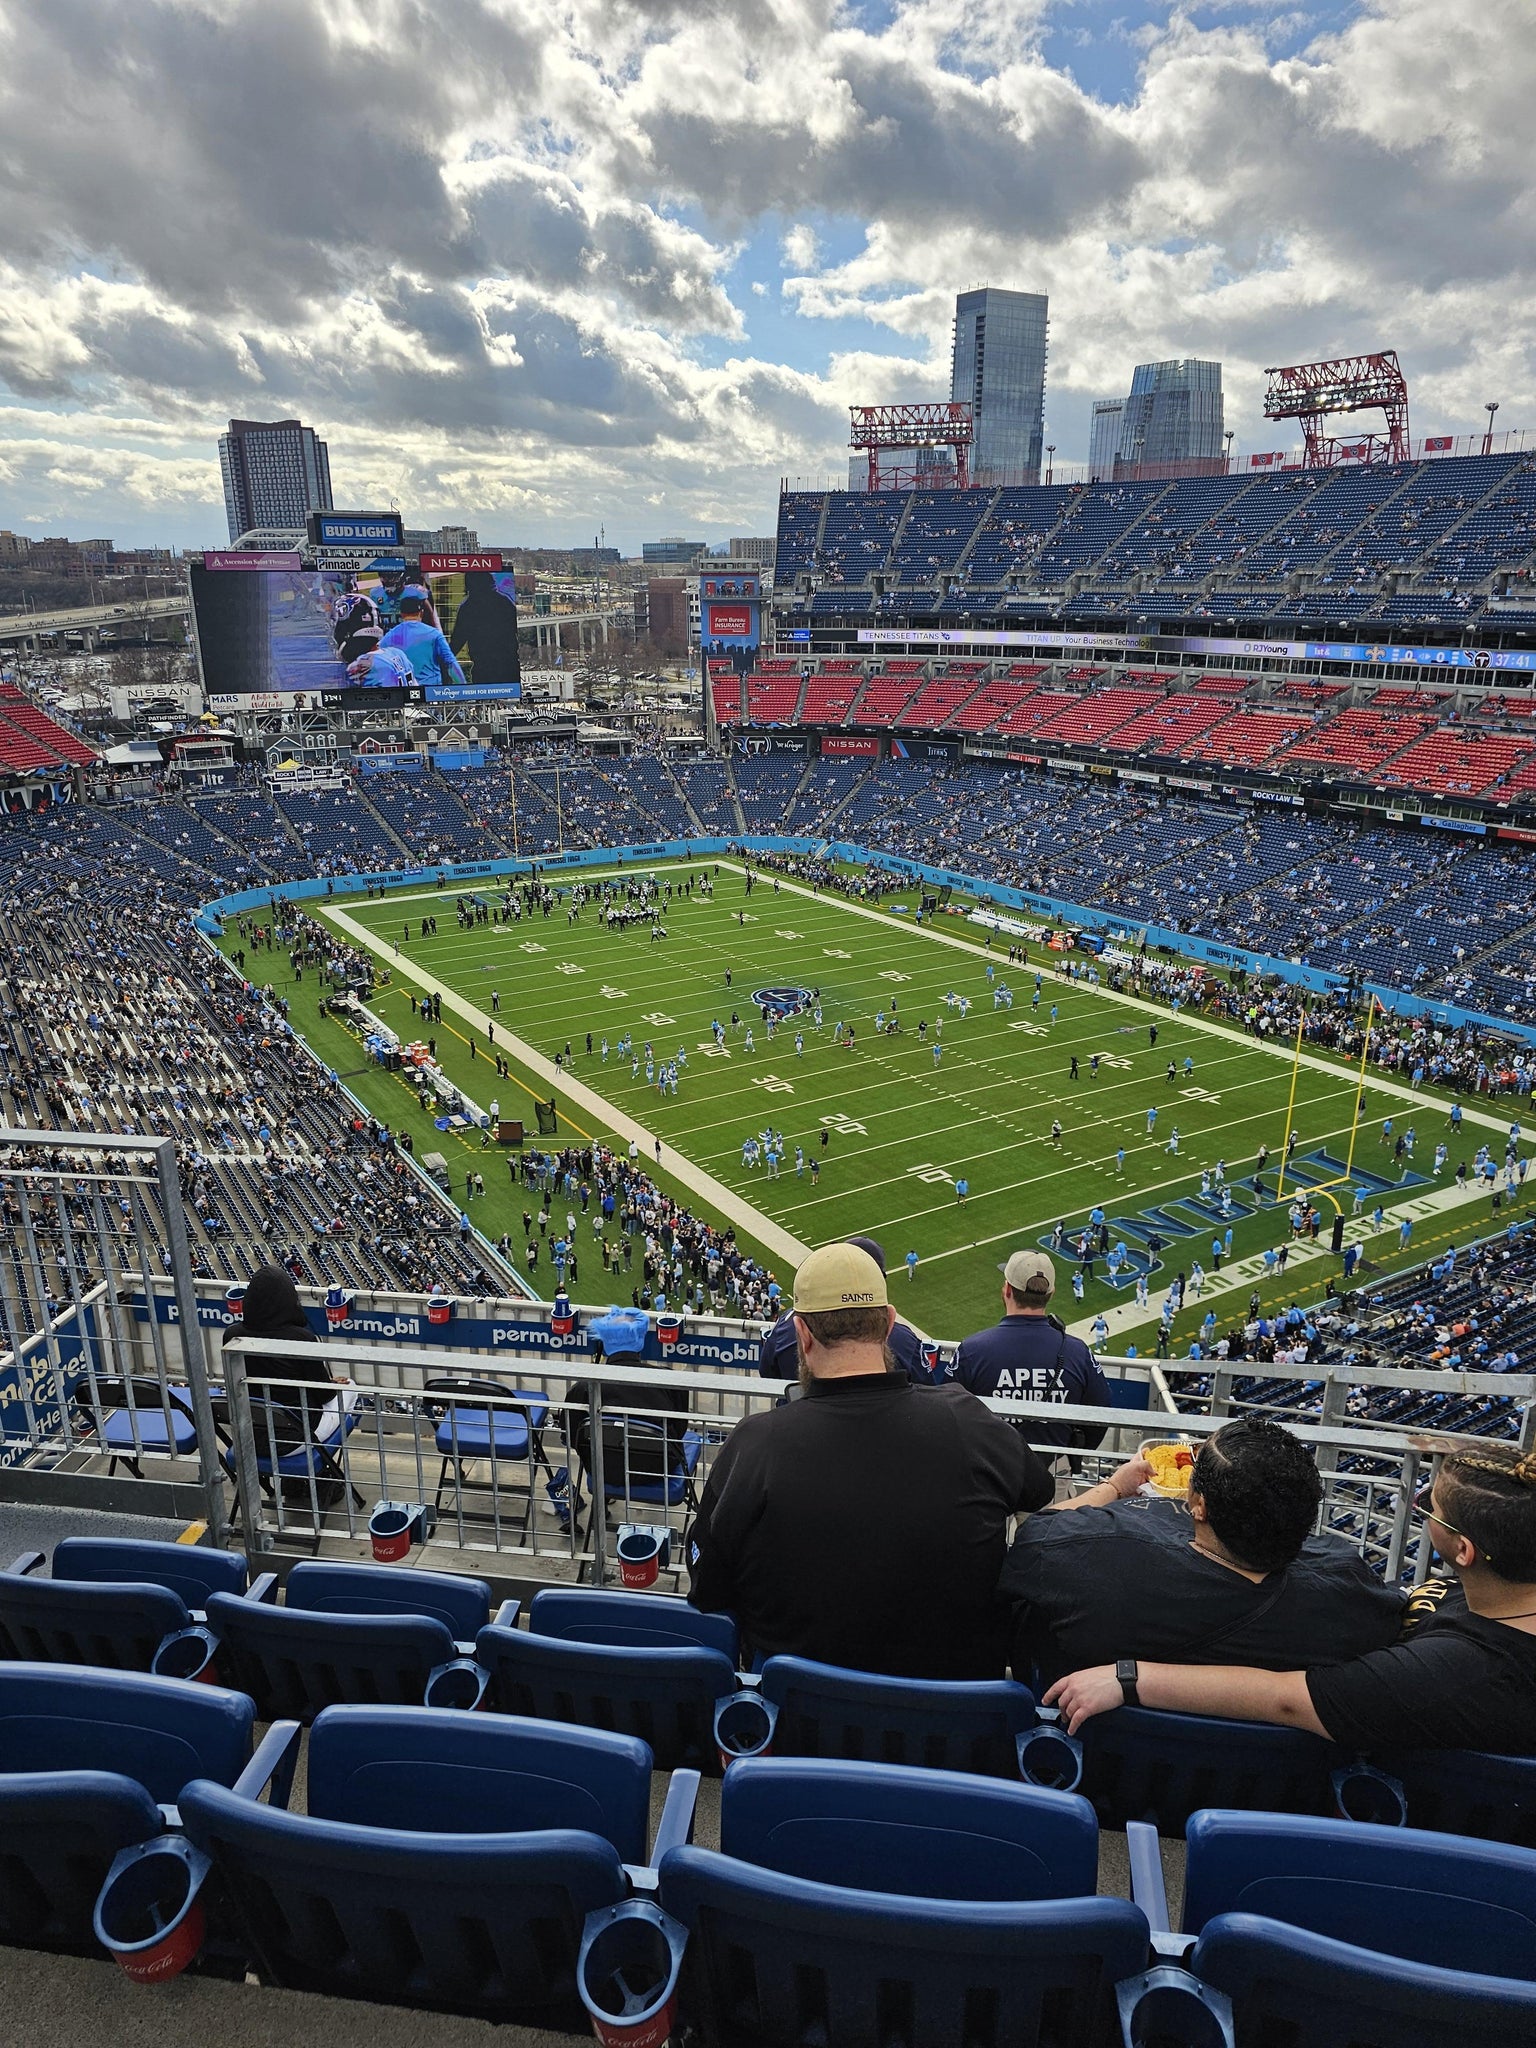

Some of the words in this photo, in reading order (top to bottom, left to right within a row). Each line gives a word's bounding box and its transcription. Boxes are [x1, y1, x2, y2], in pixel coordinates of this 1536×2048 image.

[325, 526, 354, 537] BUD
[355, 526, 393, 537] LIGHT
[318, 559, 360, 570] Pinnacle
[431, 559, 491, 567] NISSAN
[864, 632, 910, 640] TENNESSEE
[912, 632, 939, 640] TITANS
[1026, 634, 1048, 642] TITAN
[1083, 637, 1113, 646] Business
[1405, 650, 1413, 660] 0
[1436, 652, 1445, 662] 0
[1495, 653, 1530, 667] 37:41
[520, 674, 565, 683] NISSAN
[128, 688, 190, 698] NISSAN
[212, 695, 238, 703] MARS
[148, 714, 187, 722] PATHFINDER
[784, 739, 804, 751] Kroger
[1051, 760, 1081, 770] Tennessean
[1222, 786, 1238, 795] FedEx
[1252, 790, 1275, 800] ROCKY
[1275, 793, 1291, 803] LAW
[1441, 820, 1477, 831] Gallagher
[362, 876, 388, 885] TENNESSEE
[641, 1012, 676, 1026] 50
[752, 1075, 787, 1093] 30
[819, 1113, 861, 1134] 20
[906, 1163, 950, 1184] 10
[841, 1293, 873, 1303] SAINTS
[328, 1318, 420, 1337] permobil
[492, 1328, 588, 1349] permobil
[662, 1343, 759, 1363] permobil
[997, 1368, 1065, 1388] APEX
[992, 1389, 1069, 1404] SECURTY
[124, 1953, 174, 1975] Coca-Cola
